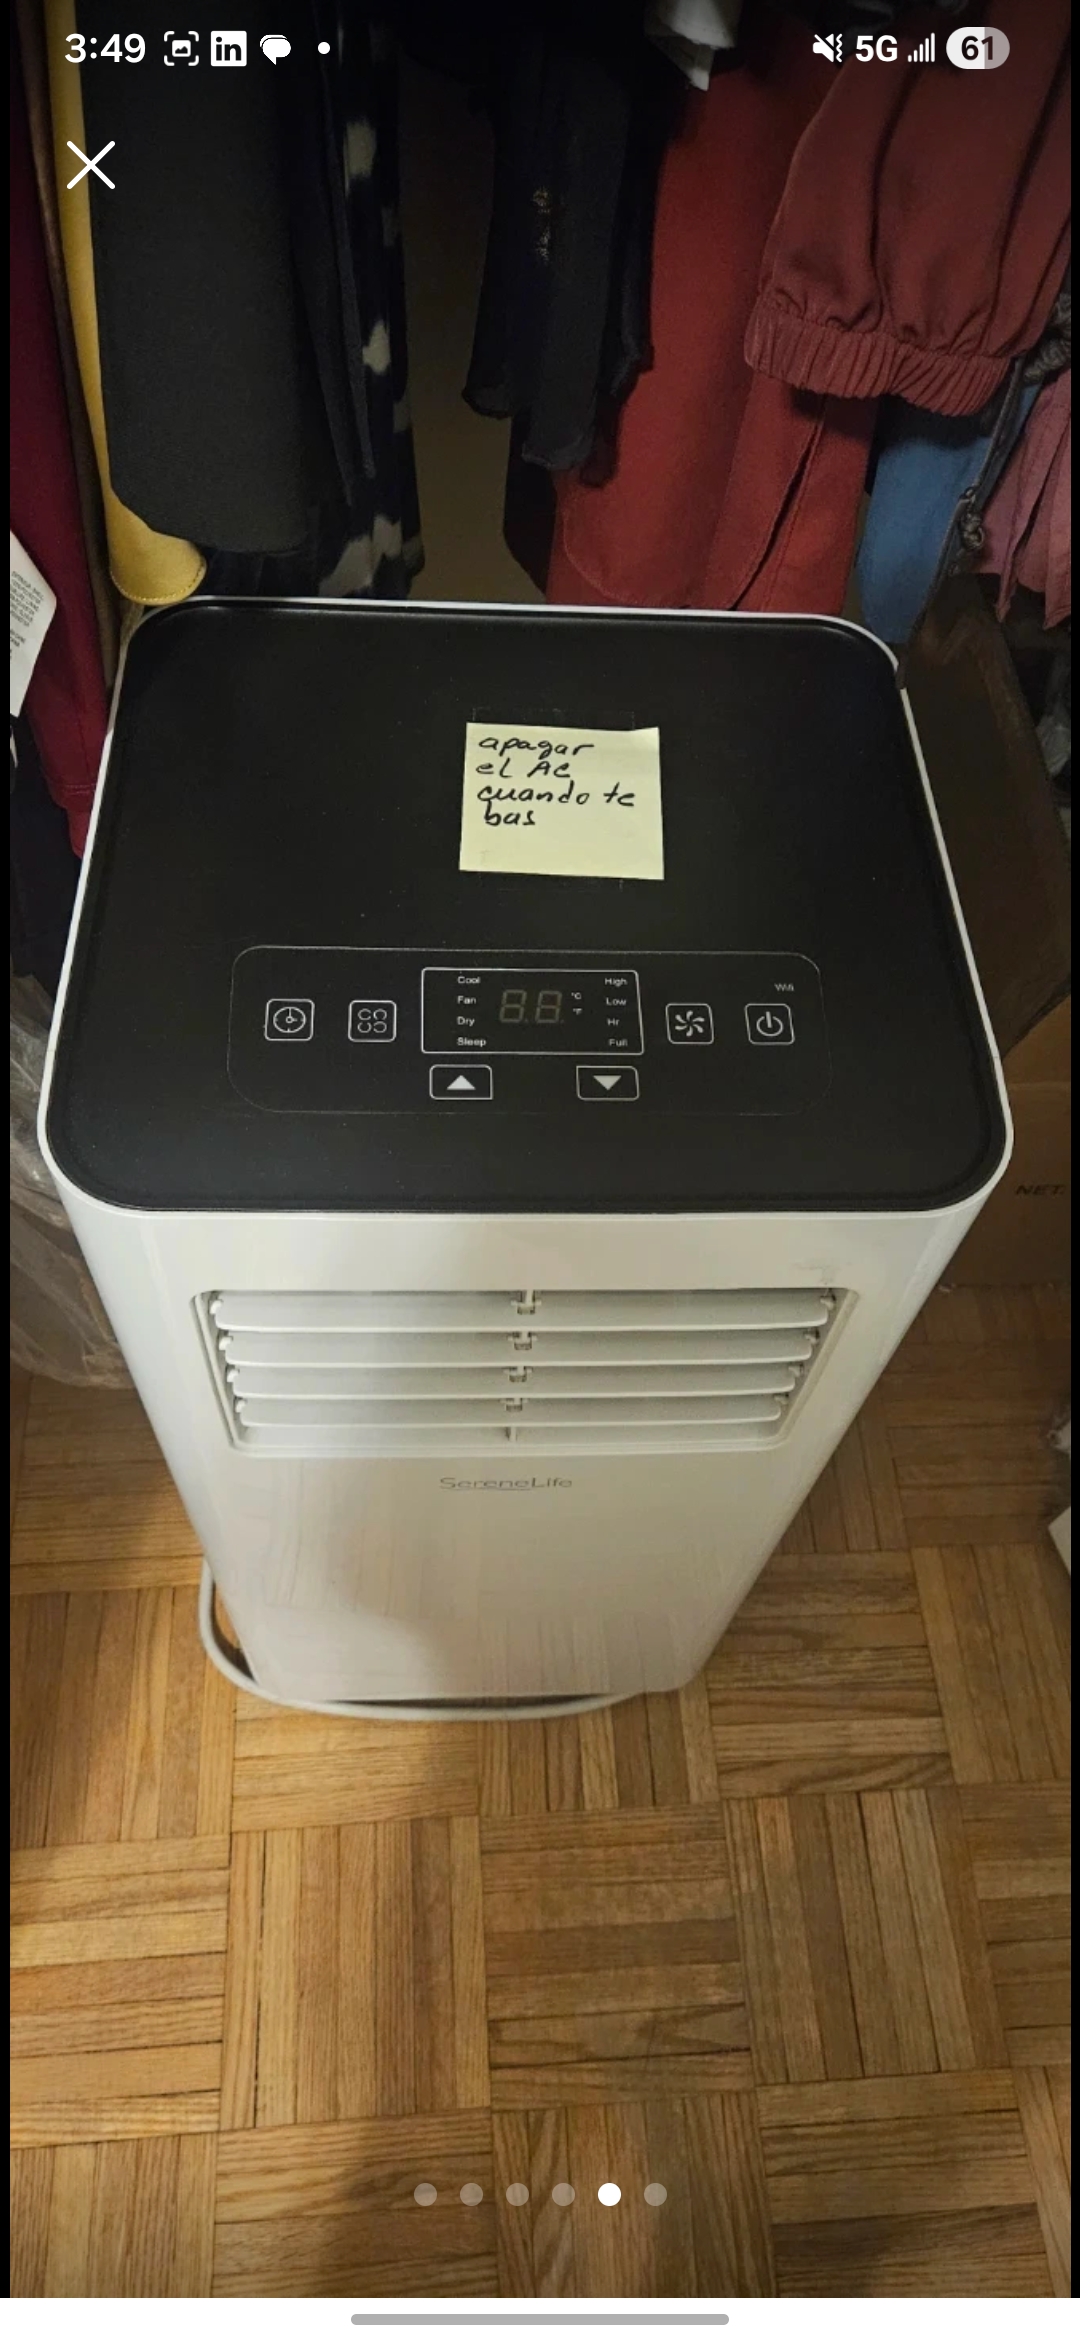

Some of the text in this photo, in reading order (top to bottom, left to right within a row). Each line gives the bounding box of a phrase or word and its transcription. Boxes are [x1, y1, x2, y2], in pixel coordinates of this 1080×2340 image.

[478, 737, 595, 760] apagar
[475, 757, 513, 778] el
[477, 780, 636, 807] cuando te
[483, 800, 536, 826] bas
[457, 975, 481, 985] Cool
[604, 977, 628, 987] High
[457, 995, 477, 1005] Fan
[605, 997, 627, 1006] Low
[457, 1016, 475, 1027] Dry
[607, 1018, 620, 1027] Hr
[457, 1037, 487, 1048] Sleep
[608, 1038, 628, 1047] Full
[439, 1477, 573, 1490] SereneLife
